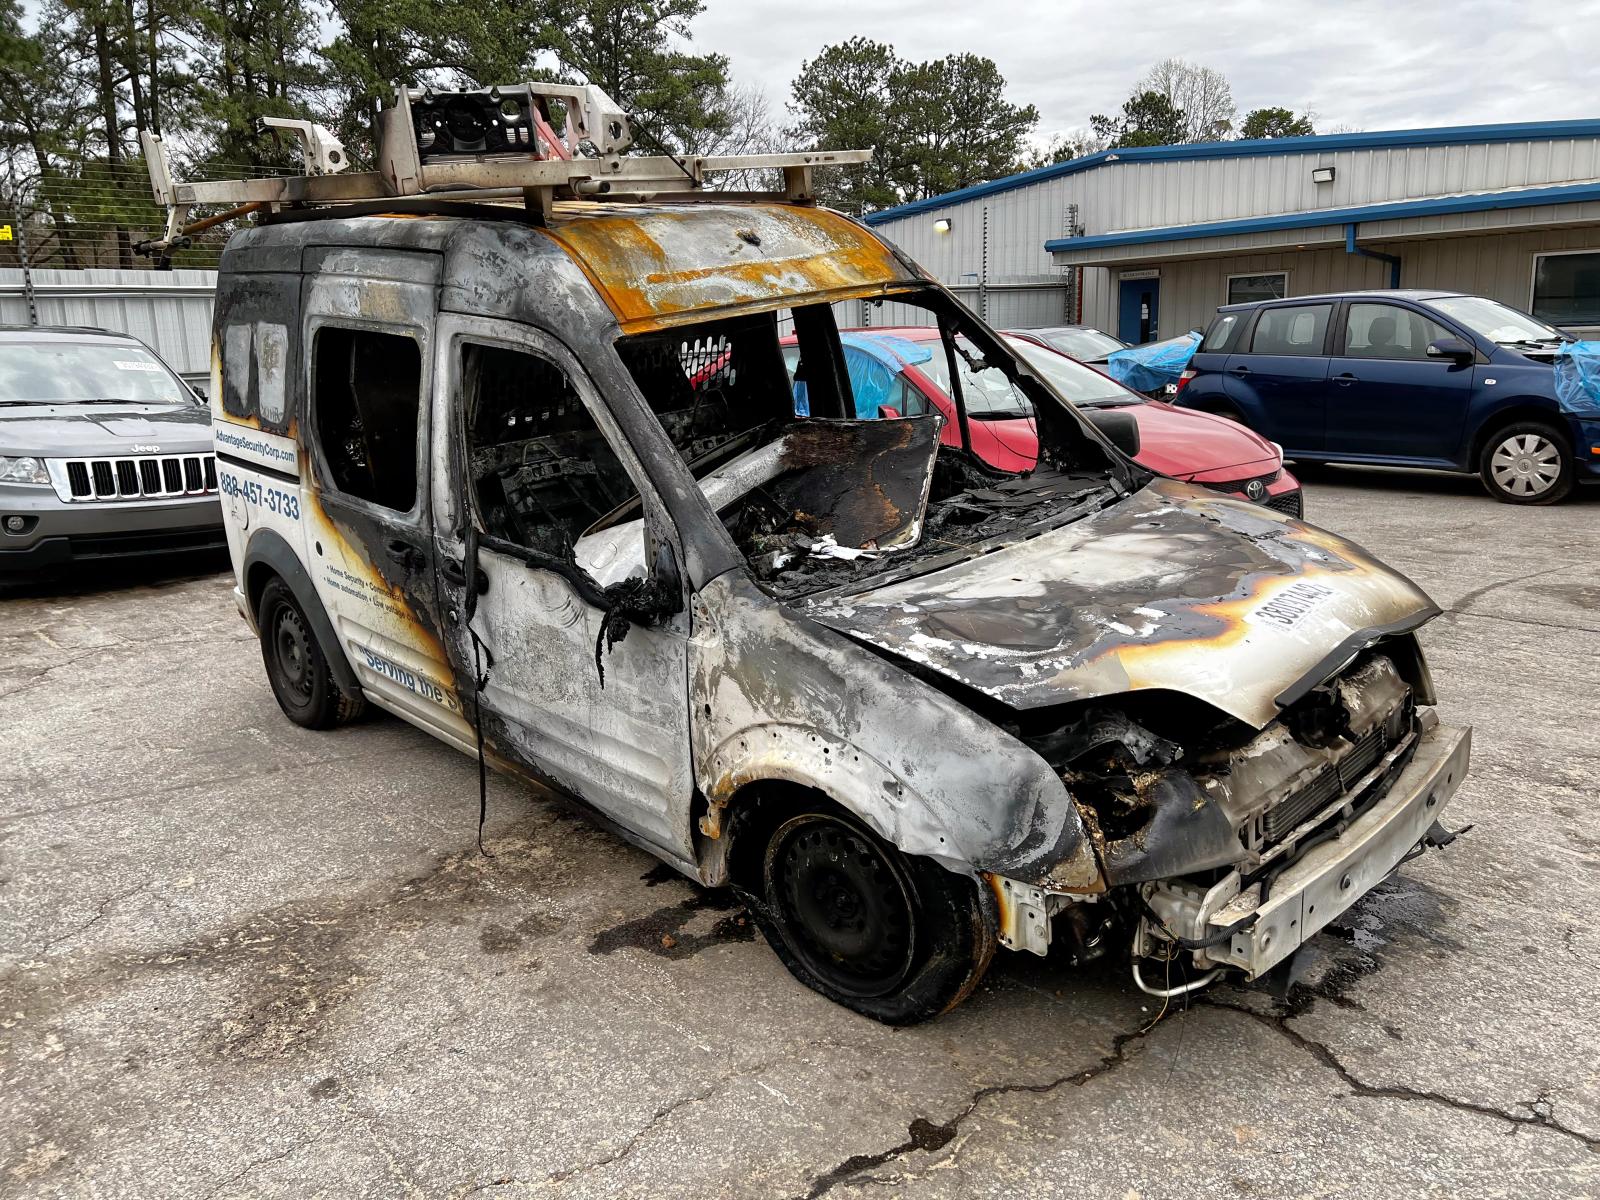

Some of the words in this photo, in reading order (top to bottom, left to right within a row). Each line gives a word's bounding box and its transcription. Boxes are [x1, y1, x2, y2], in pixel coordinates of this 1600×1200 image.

[131, 444, 160, 453] Jeep
[216, 429, 295, 462] AdvantageSecurityCorp.com
[220, 471, 300, 520] 888-457-3733
[326, 577, 341, 590] Home
[330, 564, 344, 578] Home
[344, 571, 365, 588] Security
[418, 674, 443, 703] the
